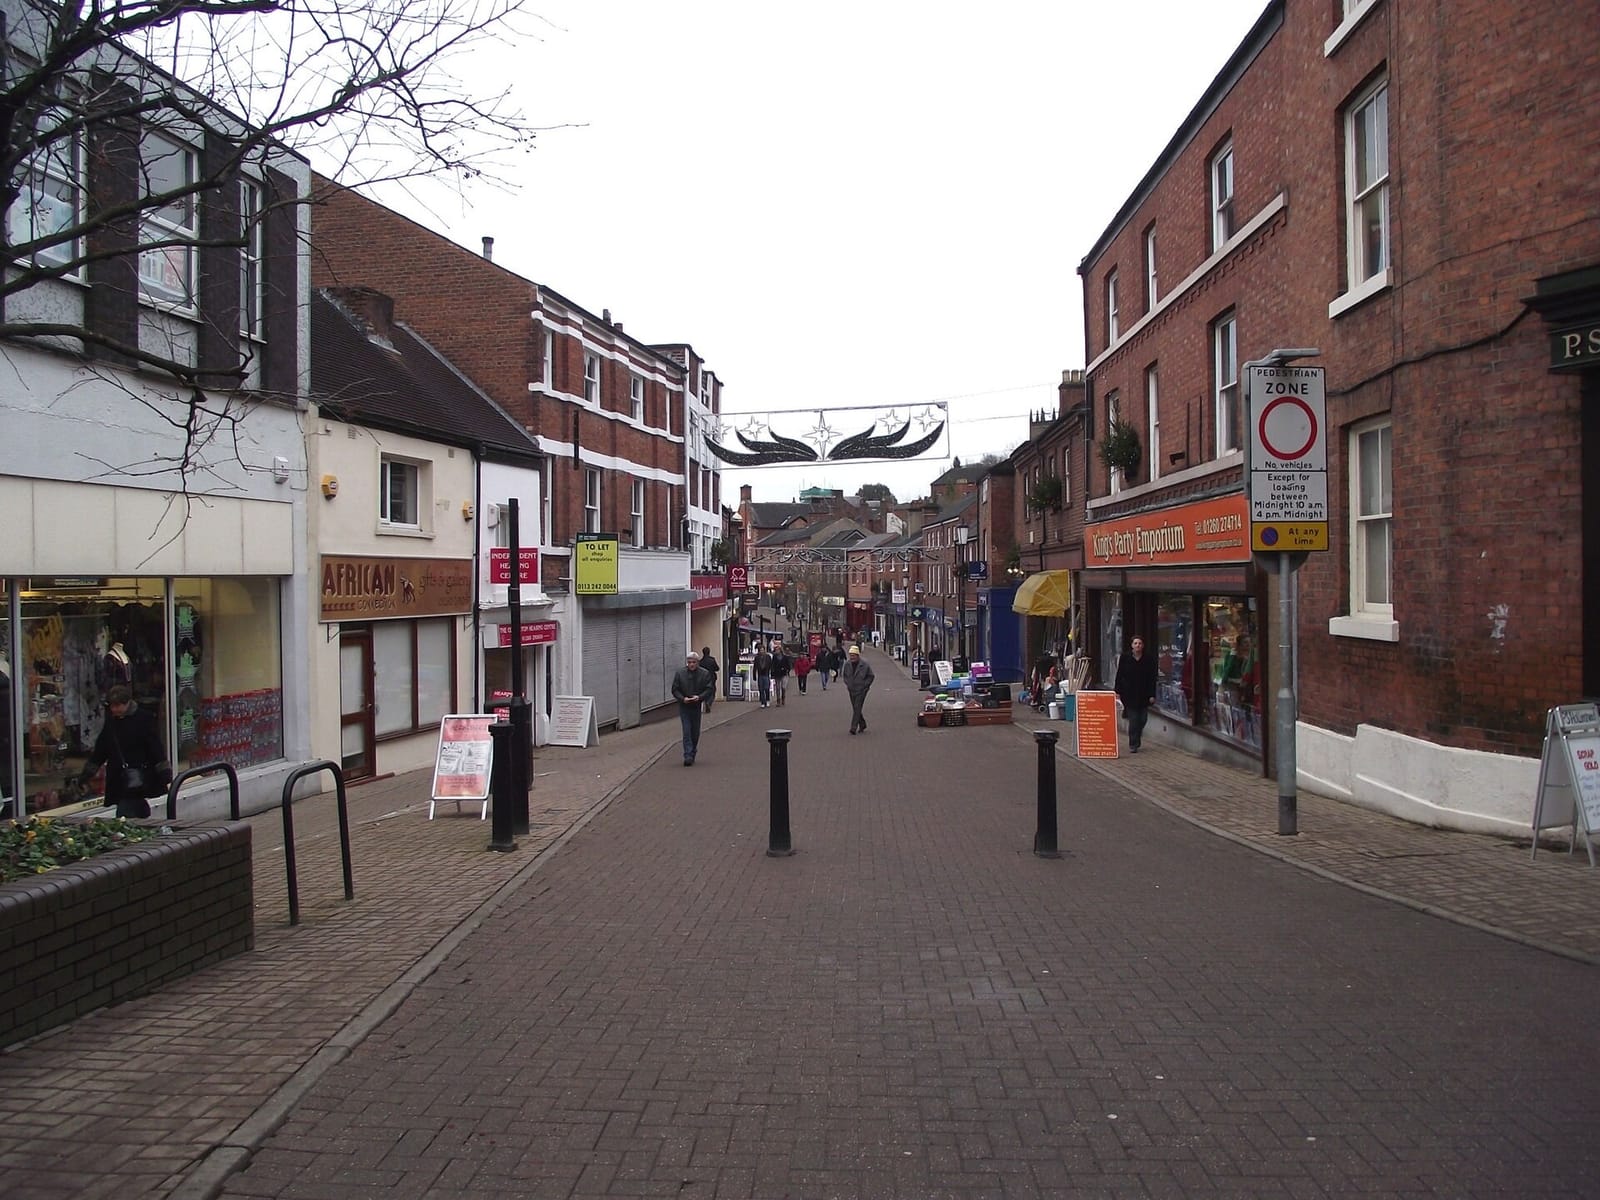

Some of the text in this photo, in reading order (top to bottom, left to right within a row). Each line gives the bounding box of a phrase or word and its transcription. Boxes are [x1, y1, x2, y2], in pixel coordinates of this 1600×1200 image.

[1257, 369, 1318, 377] PEDESTRIAN
[1265, 382, 1309, 395] ZONE
[1265, 461, 1313, 469] No vehicles
[1267, 473, 1310, 482] Except for
[1272, 483, 1306, 492] loading
[1270, 493, 1308, 501] between
[1254, 501, 1294, 510] Midnight
[1296, 501, 1304, 509] 10
[1284, 510, 1323, 519] Midnight
[1114, 529, 1134, 561] Party
[1136, 520, 1185, 561] Emporium
[585, 543, 609, 551] TO LET
[322, 562, 395, 597] AFRICAN
